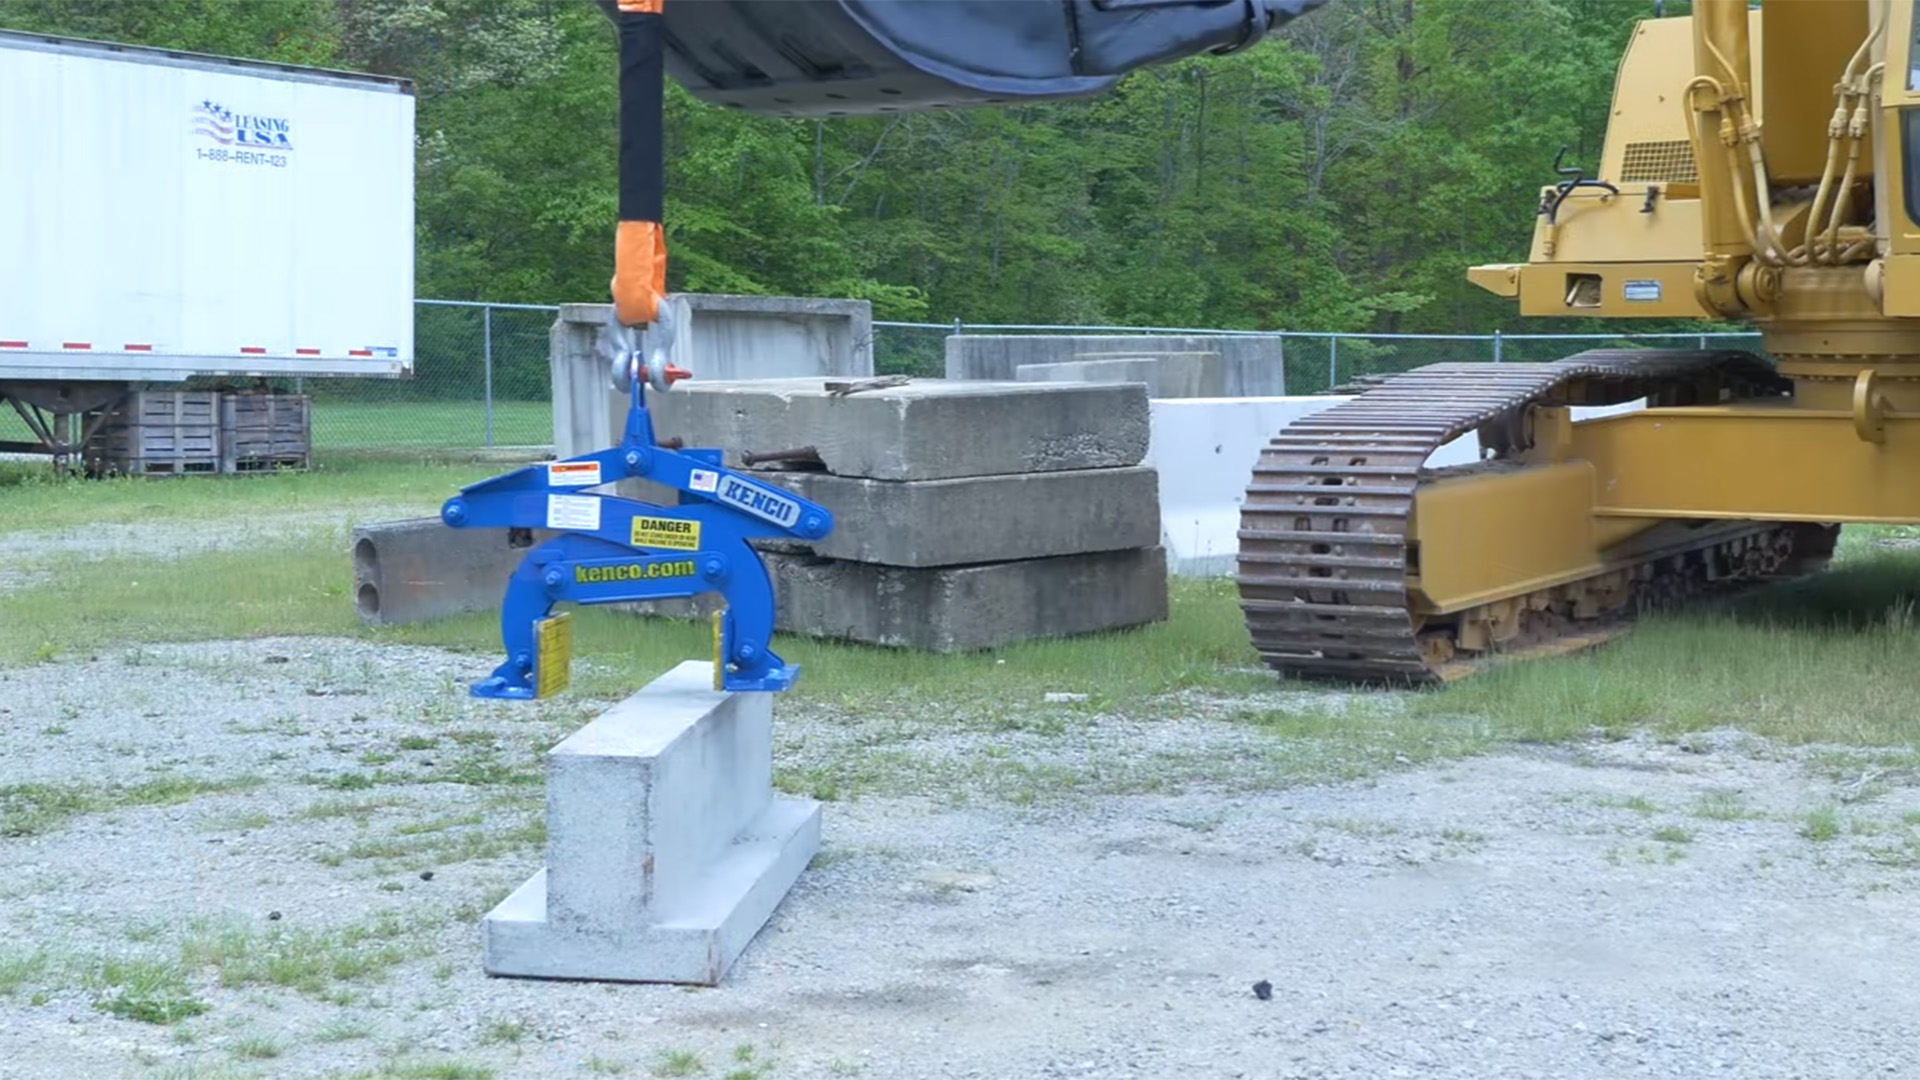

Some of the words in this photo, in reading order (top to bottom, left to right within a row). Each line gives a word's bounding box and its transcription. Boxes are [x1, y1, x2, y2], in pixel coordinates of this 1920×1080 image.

[235, 114, 289, 132] LEASING
[236, 129, 291, 146] USA
[197, 147, 287, 168] 1-888-RENT-123
[724, 480, 793, 522] KENCO
[641, 519, 692, 533] DANGER
[575, 560, 695, 583] kenco.com
